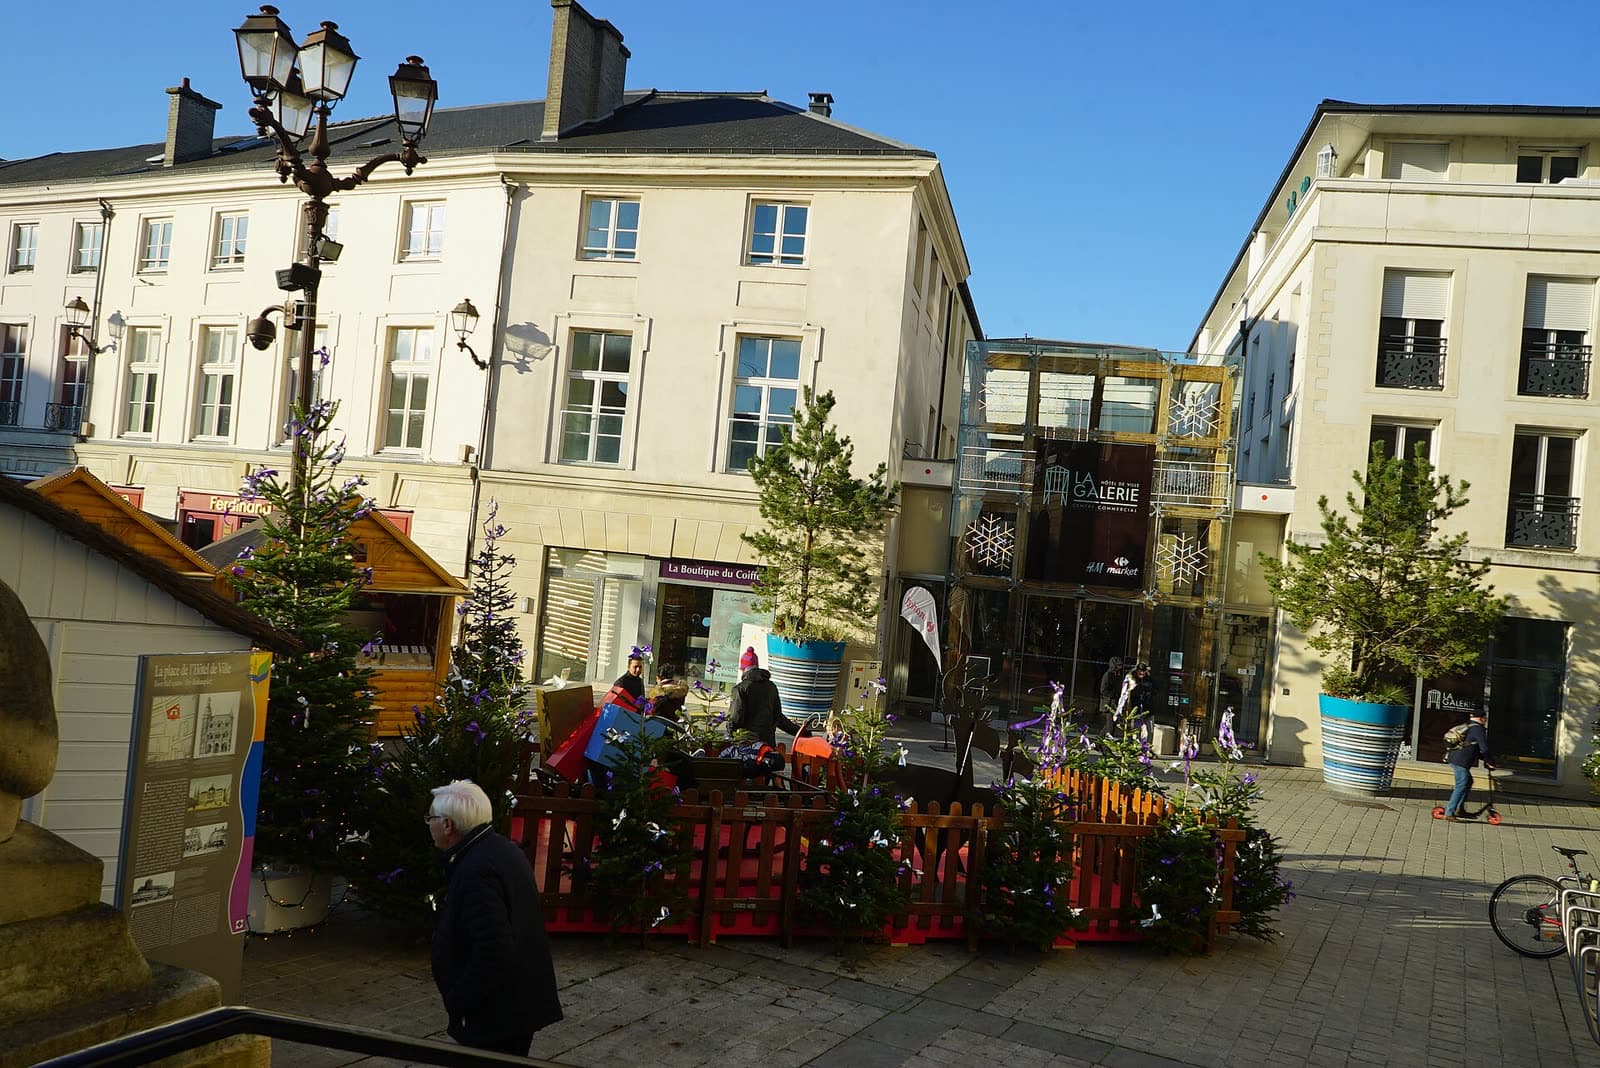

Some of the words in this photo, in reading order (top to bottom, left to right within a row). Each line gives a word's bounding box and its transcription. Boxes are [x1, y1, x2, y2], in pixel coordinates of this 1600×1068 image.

[1075, 472, 1096, 484] LA
[1073, 484, 1140, 502] GALERIE
[210, 496, 272, 515] Ferdinand
[668, 563, 678, 573] La
[680, 565, 720, 578] Boutique
[722, 568, 733, 578] du
[736, 570, 761, 581] Coiffe
[1107, 567, 1139, 576] market
[155, 664, 163, 677] La
[164, 664, 180, 680] place
[181, 663, 188, 676] de
[210, 663, 218, 674] de
[218, 662, 232, 674] Ville
